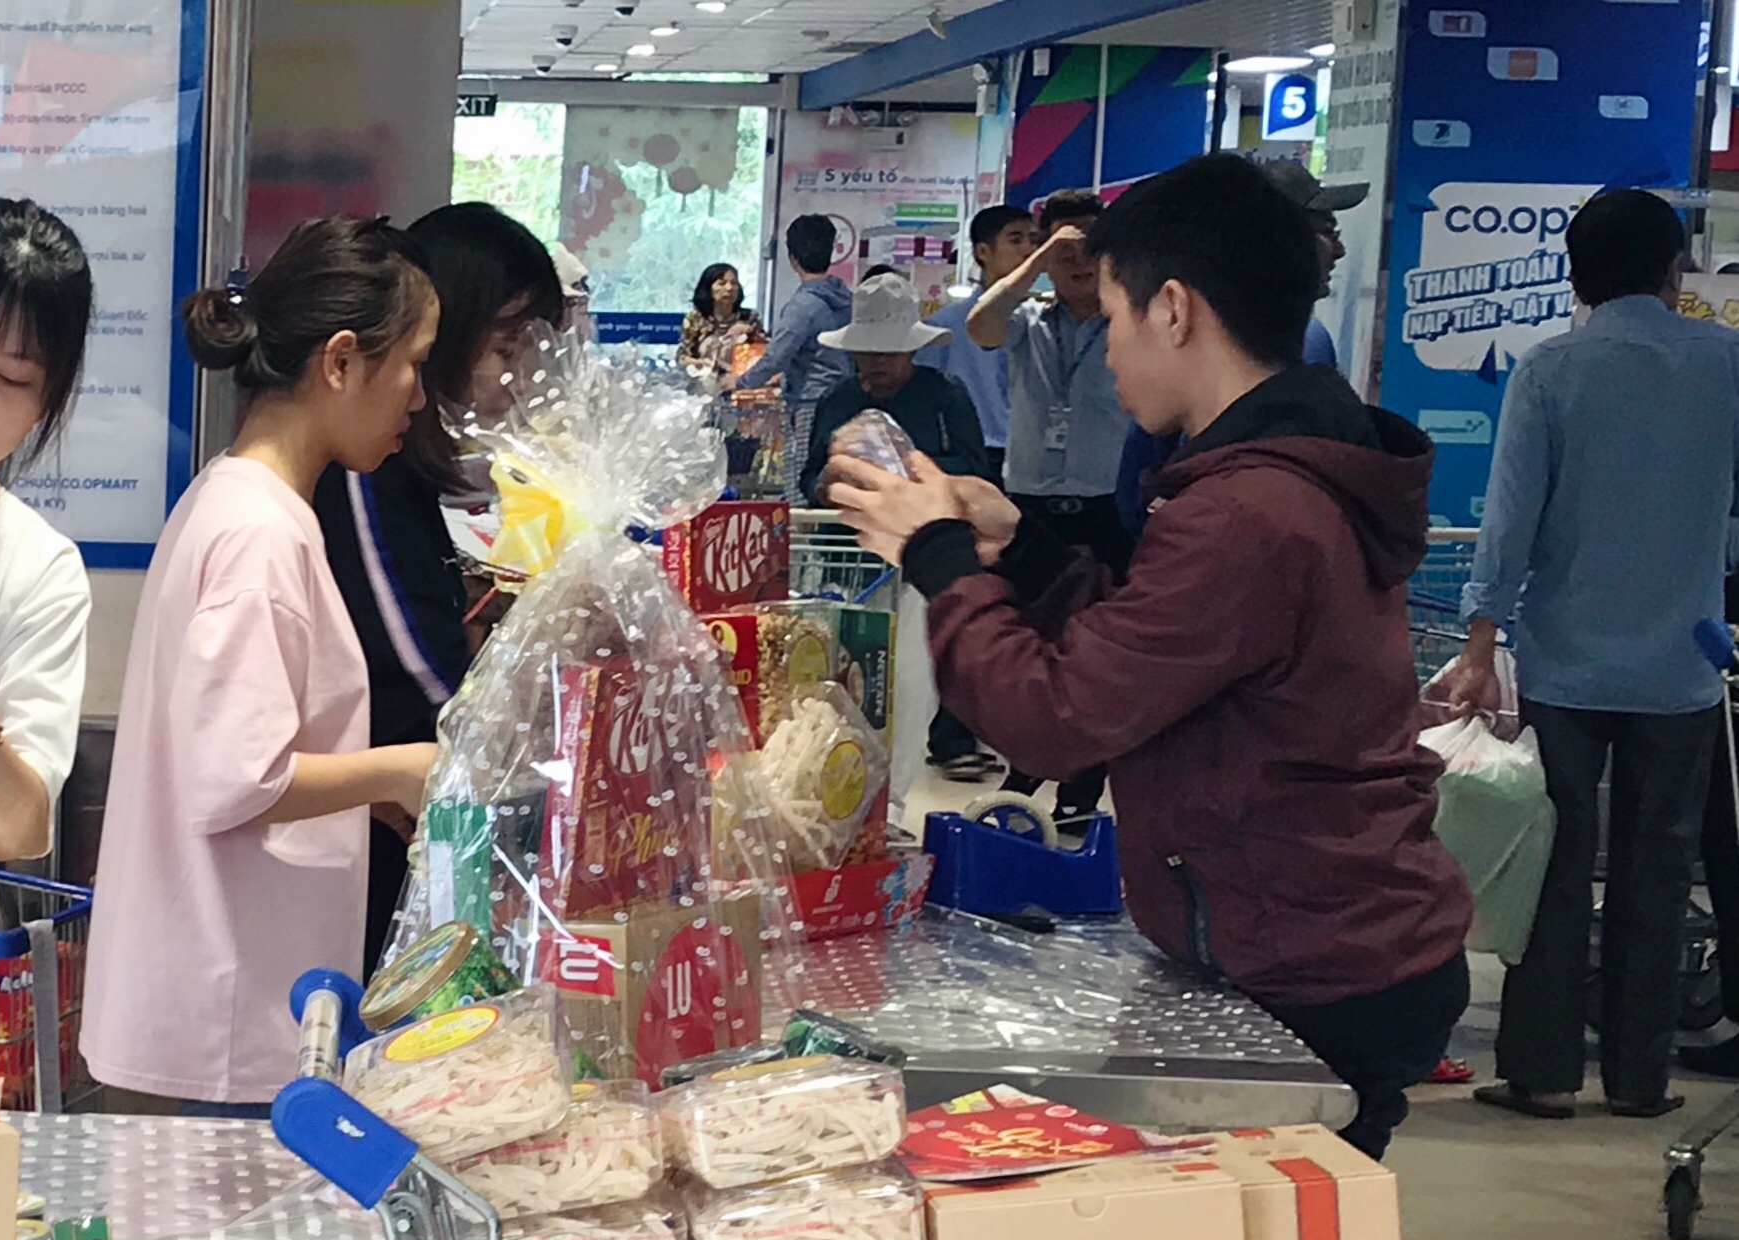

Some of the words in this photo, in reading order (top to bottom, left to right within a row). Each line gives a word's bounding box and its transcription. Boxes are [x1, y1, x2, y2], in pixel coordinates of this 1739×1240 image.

[455, 96, 491, 115] XIT
[1281, 85, 1307, 119] 5
[824, 168, 836, 184] 5
[840, 166, 873, 186] yếu
[877, 165, 899, 184] tố
[1412, 263, 1495, 303] THANH
[1494, 248, 1562, 292] TOÁN
[1408, 307, 1456, 342] NẠP
[1453, 298, 1504, 334] TIỀN
[706, 511, 770, 594] KitKat
